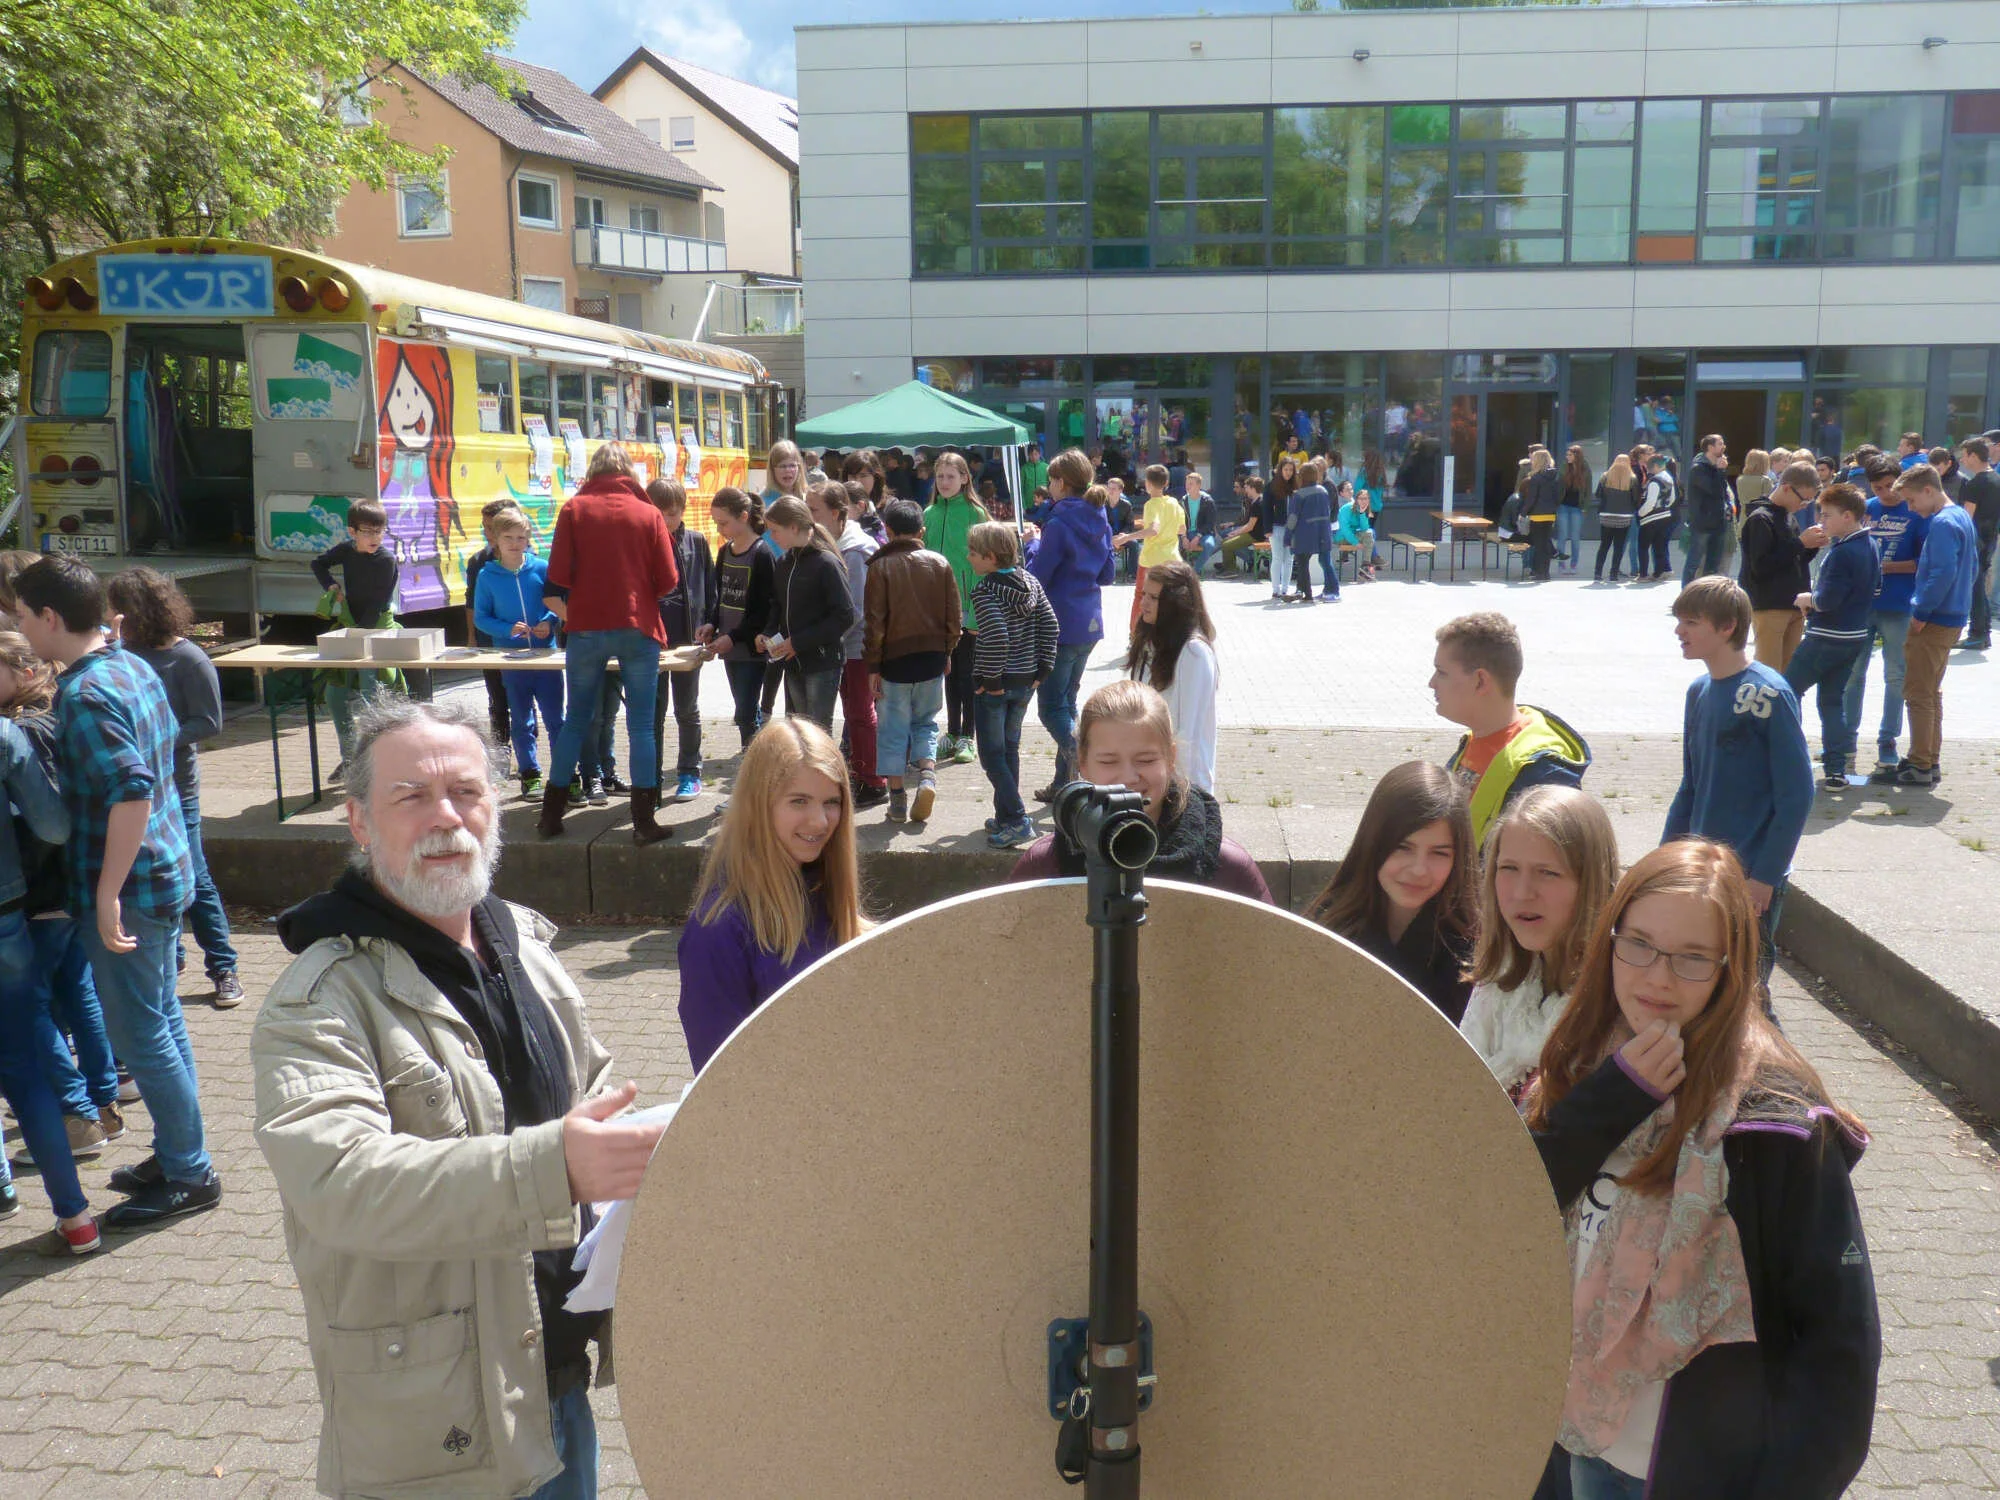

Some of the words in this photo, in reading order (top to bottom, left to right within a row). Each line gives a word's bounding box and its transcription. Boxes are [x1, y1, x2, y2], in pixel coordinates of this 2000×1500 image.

[135, 269, 256, 310] KJR
[58, 536, 66, 550] S
[74, 536, 90, 552] CT
[92, 538, 108, 551] 11
[1733, 683, 1779, 719] 95
